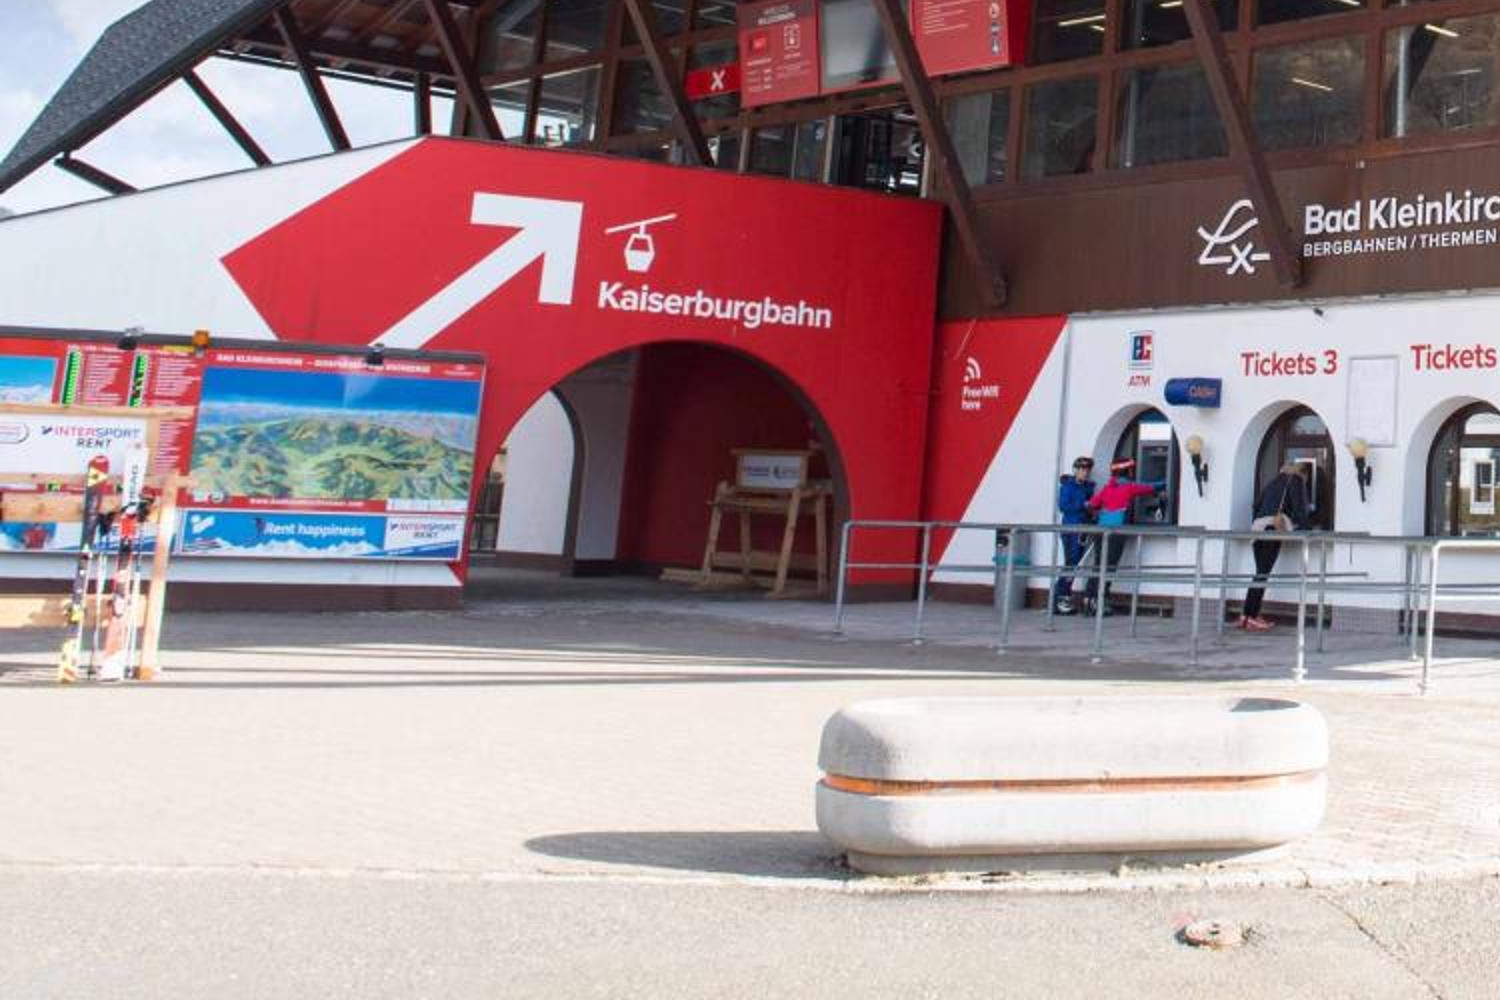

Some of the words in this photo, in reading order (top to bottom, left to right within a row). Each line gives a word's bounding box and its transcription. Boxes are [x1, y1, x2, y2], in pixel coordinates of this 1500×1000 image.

[1304, 202, 1362, 235] Bad
[1303, 236, 1407, 257] BERGBAHNEN
[1420, 229, 1497, 249] THERMEN
[598, 281, 832, 328] Kaiserburgbahn
[1241, 352, 1316, 377] Tickets
[1323, 350, 1338, 375] 3
[1410, 344, 1497, 370] Tickets
[1128, 375, 1151, 387] ATM
[55, 425, 140, 438] INTERSPORT
[77, 438, 112, 448] RENT
[264, 523, 296, 535] Rent
[298, 523, 366, 538] happiness
